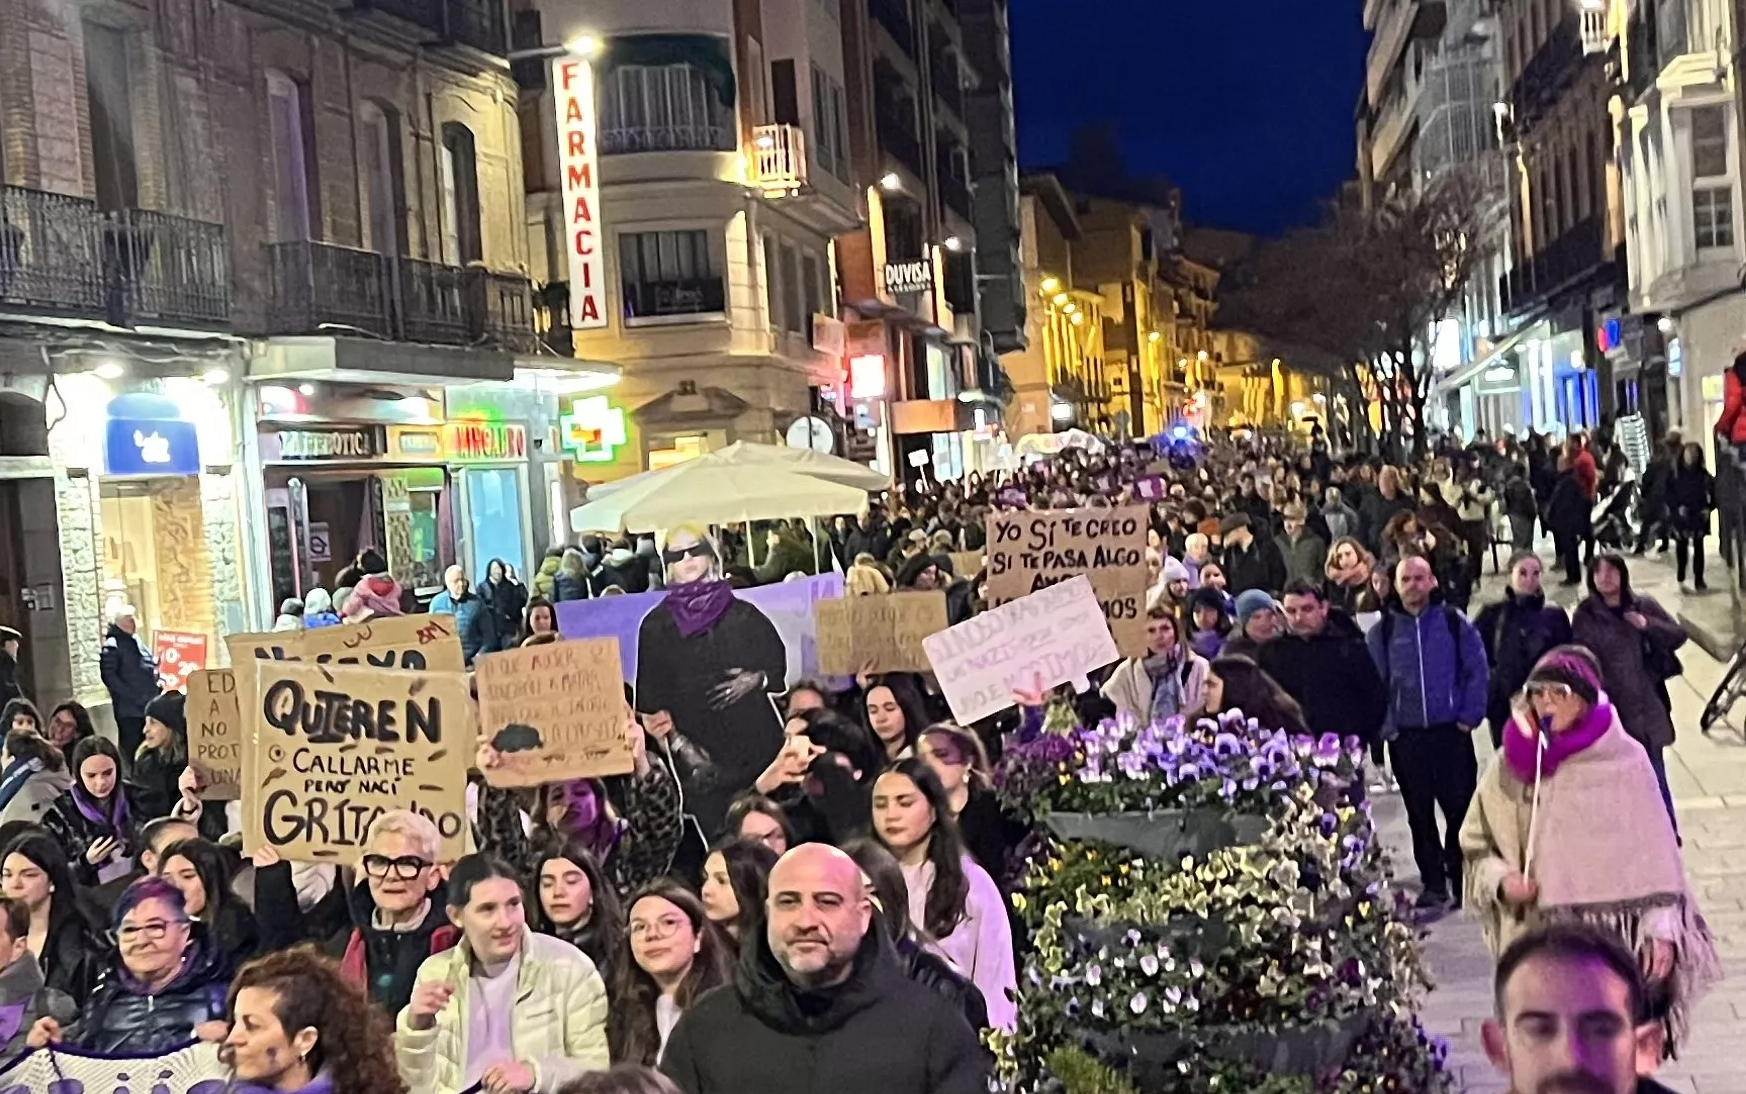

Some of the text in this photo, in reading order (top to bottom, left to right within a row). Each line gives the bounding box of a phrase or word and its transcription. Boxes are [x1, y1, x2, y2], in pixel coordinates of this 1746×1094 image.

[560, 62, 600, 323] FARMACIA
[885, 261, 931, 285] DUVISA
[995, 520, 1022, 544] YO
[1061, 517, 1083, 538] TE
[1085, 517, 1138, 539] CREO
[991, 545, 1141, 576] SI TE PASA ALGO
[415, 620, 451, 645] 8M
[262, 679, 442, 745] QUIEREN
[201, 721, 227, 738] NO
[304, 778, 351, 795] PERO
